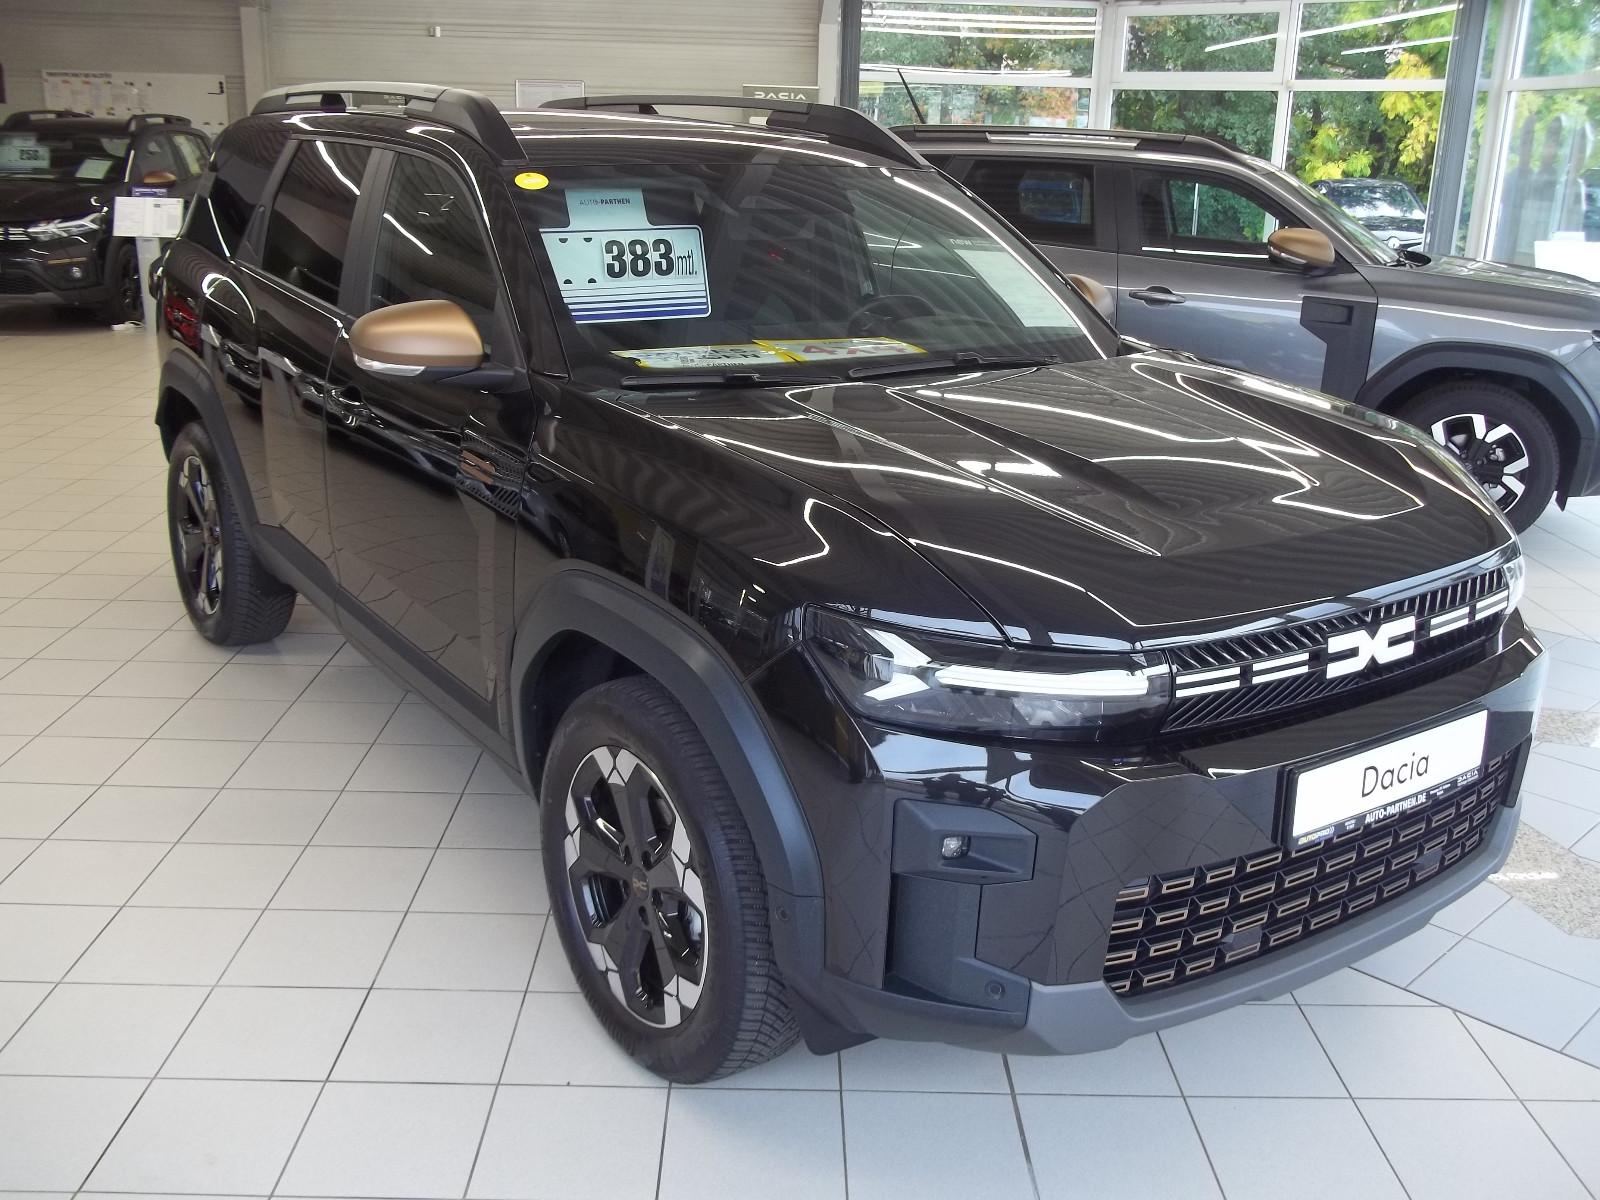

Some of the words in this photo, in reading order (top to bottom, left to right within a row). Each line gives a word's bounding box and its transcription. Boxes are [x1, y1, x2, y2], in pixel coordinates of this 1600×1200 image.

[754, 91, 806, 100] DACIA
[604, 238, 675, 279] 383
[676, 249, 698, 276] mtl.
[1361, 751, 1429, 798] Dacia
[1364, 792, 1427, 824] AUTO-PARTHEN.DE
